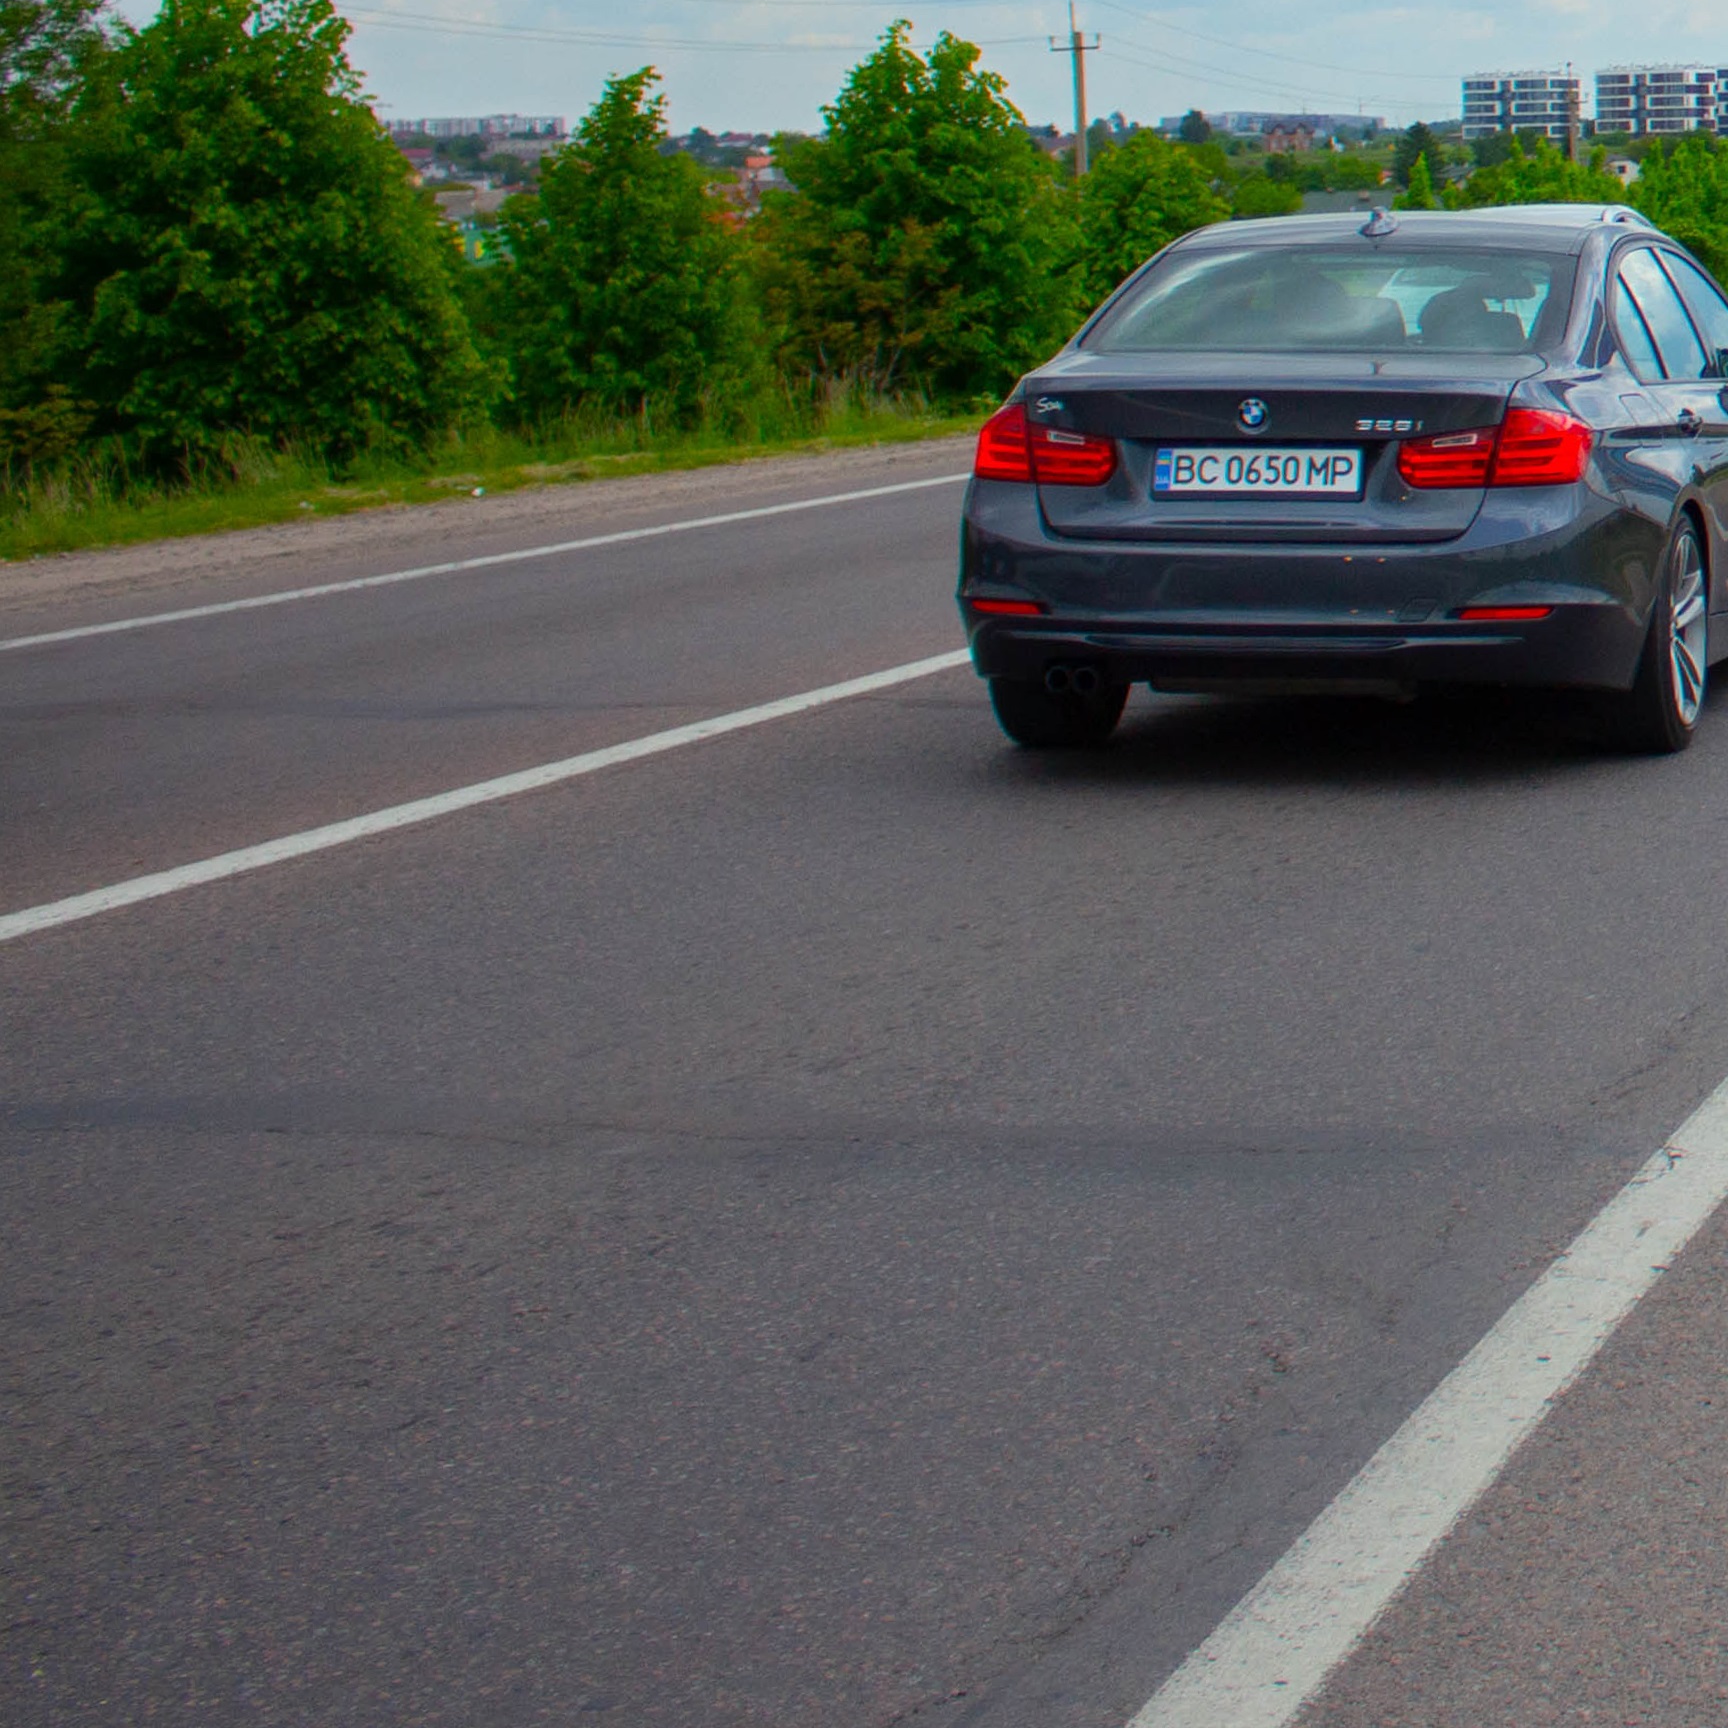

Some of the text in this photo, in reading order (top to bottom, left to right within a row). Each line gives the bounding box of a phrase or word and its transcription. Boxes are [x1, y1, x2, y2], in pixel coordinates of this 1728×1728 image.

[1174, 455, 1353, 485] BC 0650 MP
